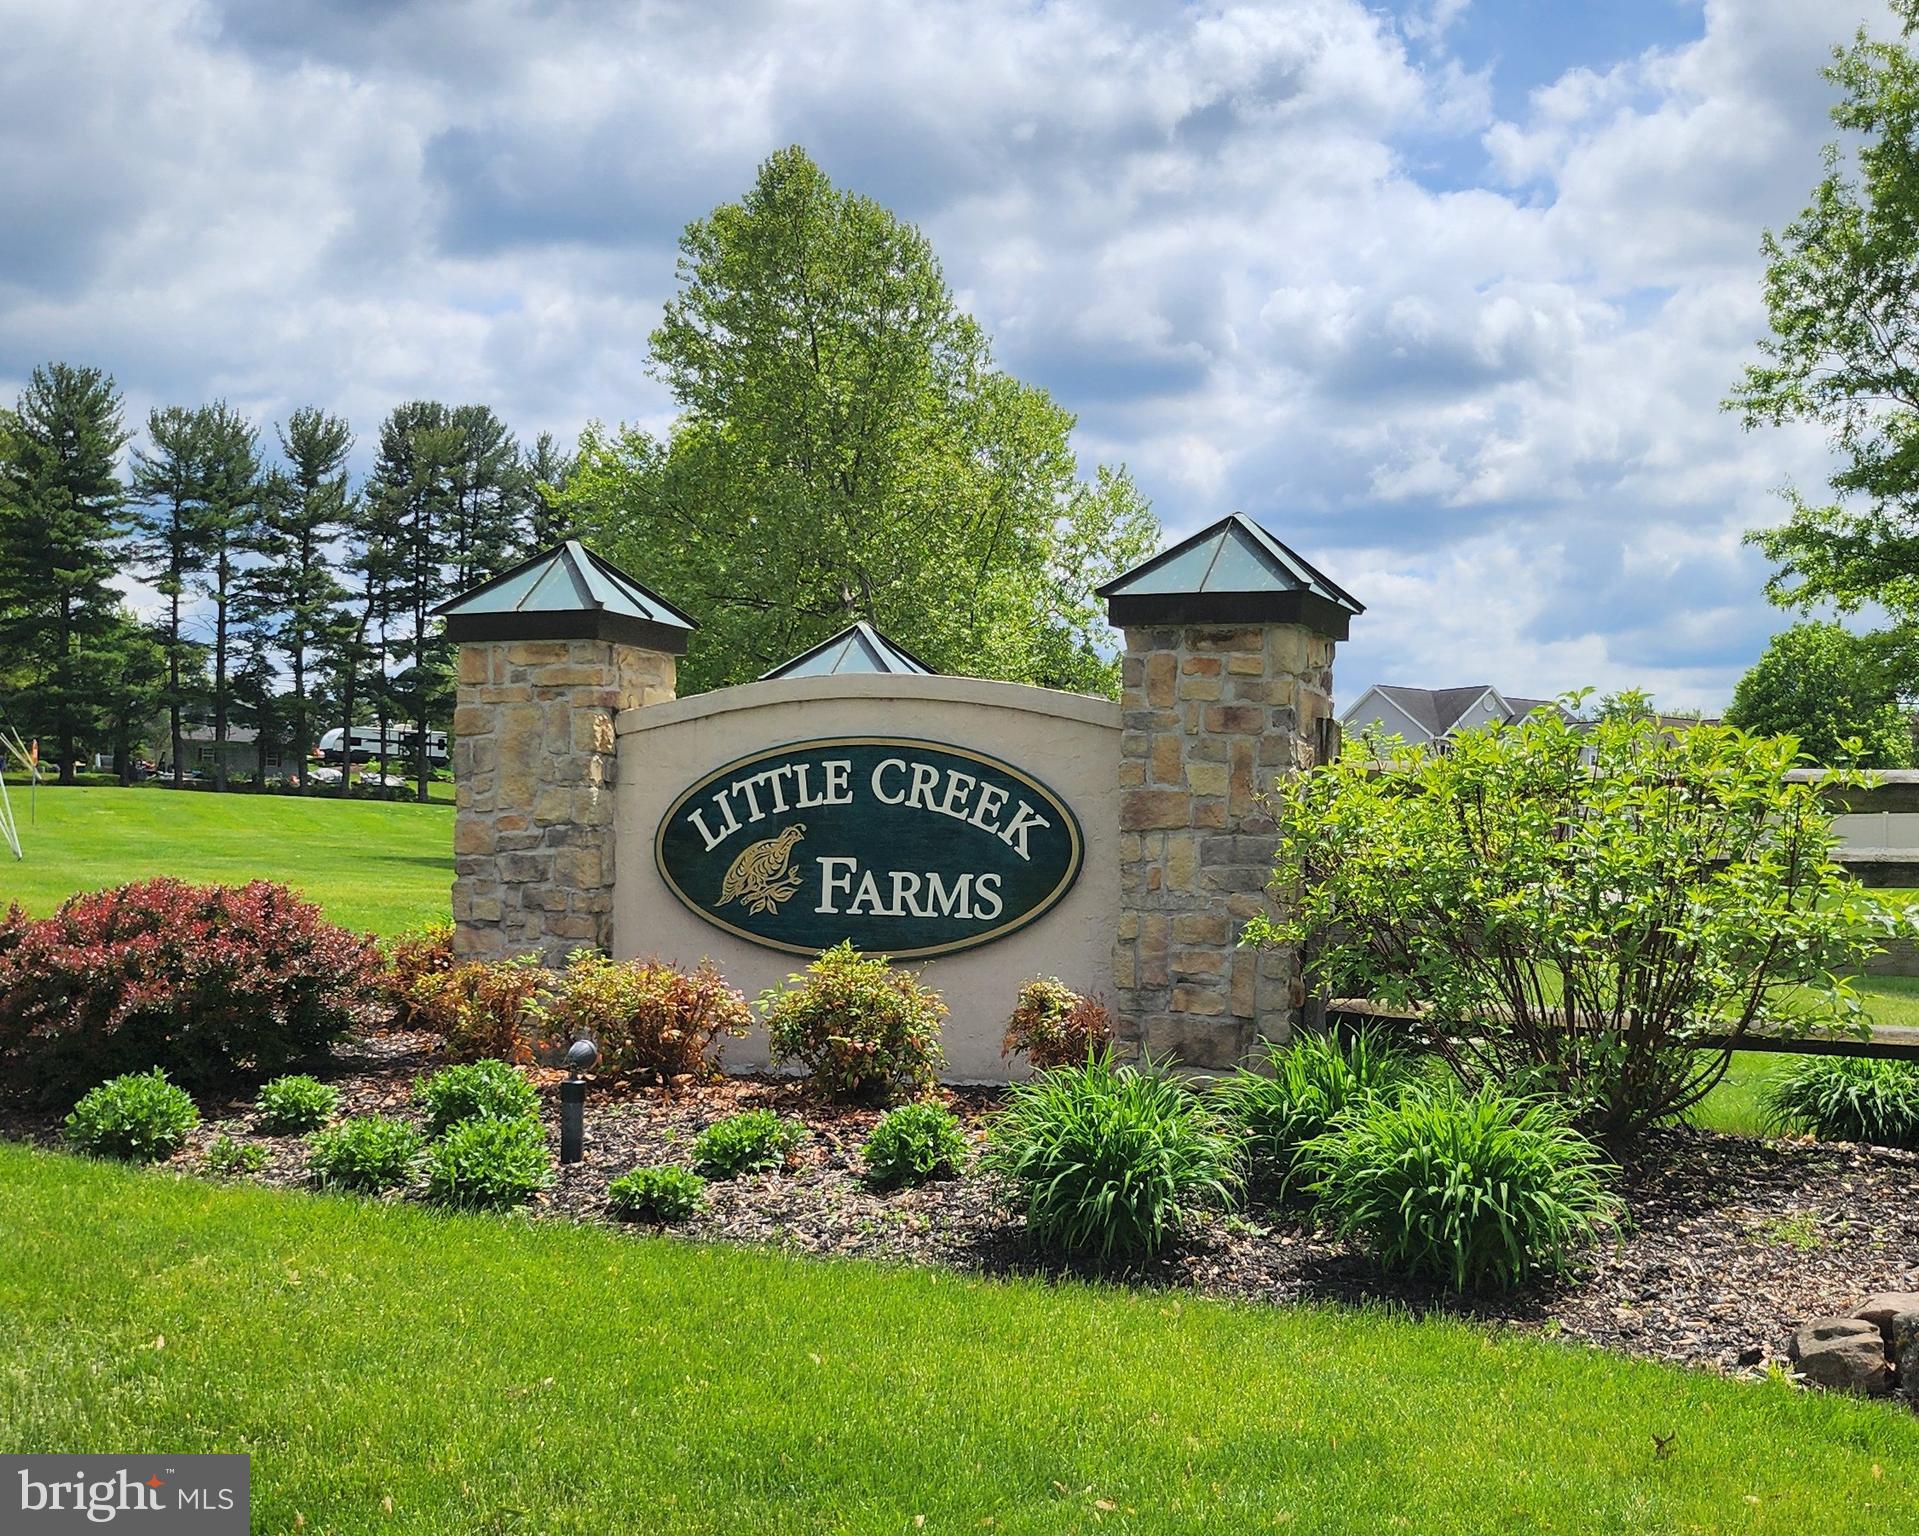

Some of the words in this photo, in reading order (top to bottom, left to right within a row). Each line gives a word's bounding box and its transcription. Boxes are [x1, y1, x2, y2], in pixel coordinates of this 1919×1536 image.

[687, 759, 853, 852] LITTLE
[871, 758, 1050, 861] CREEK
[814, 856, 1003, 920] FARMS
